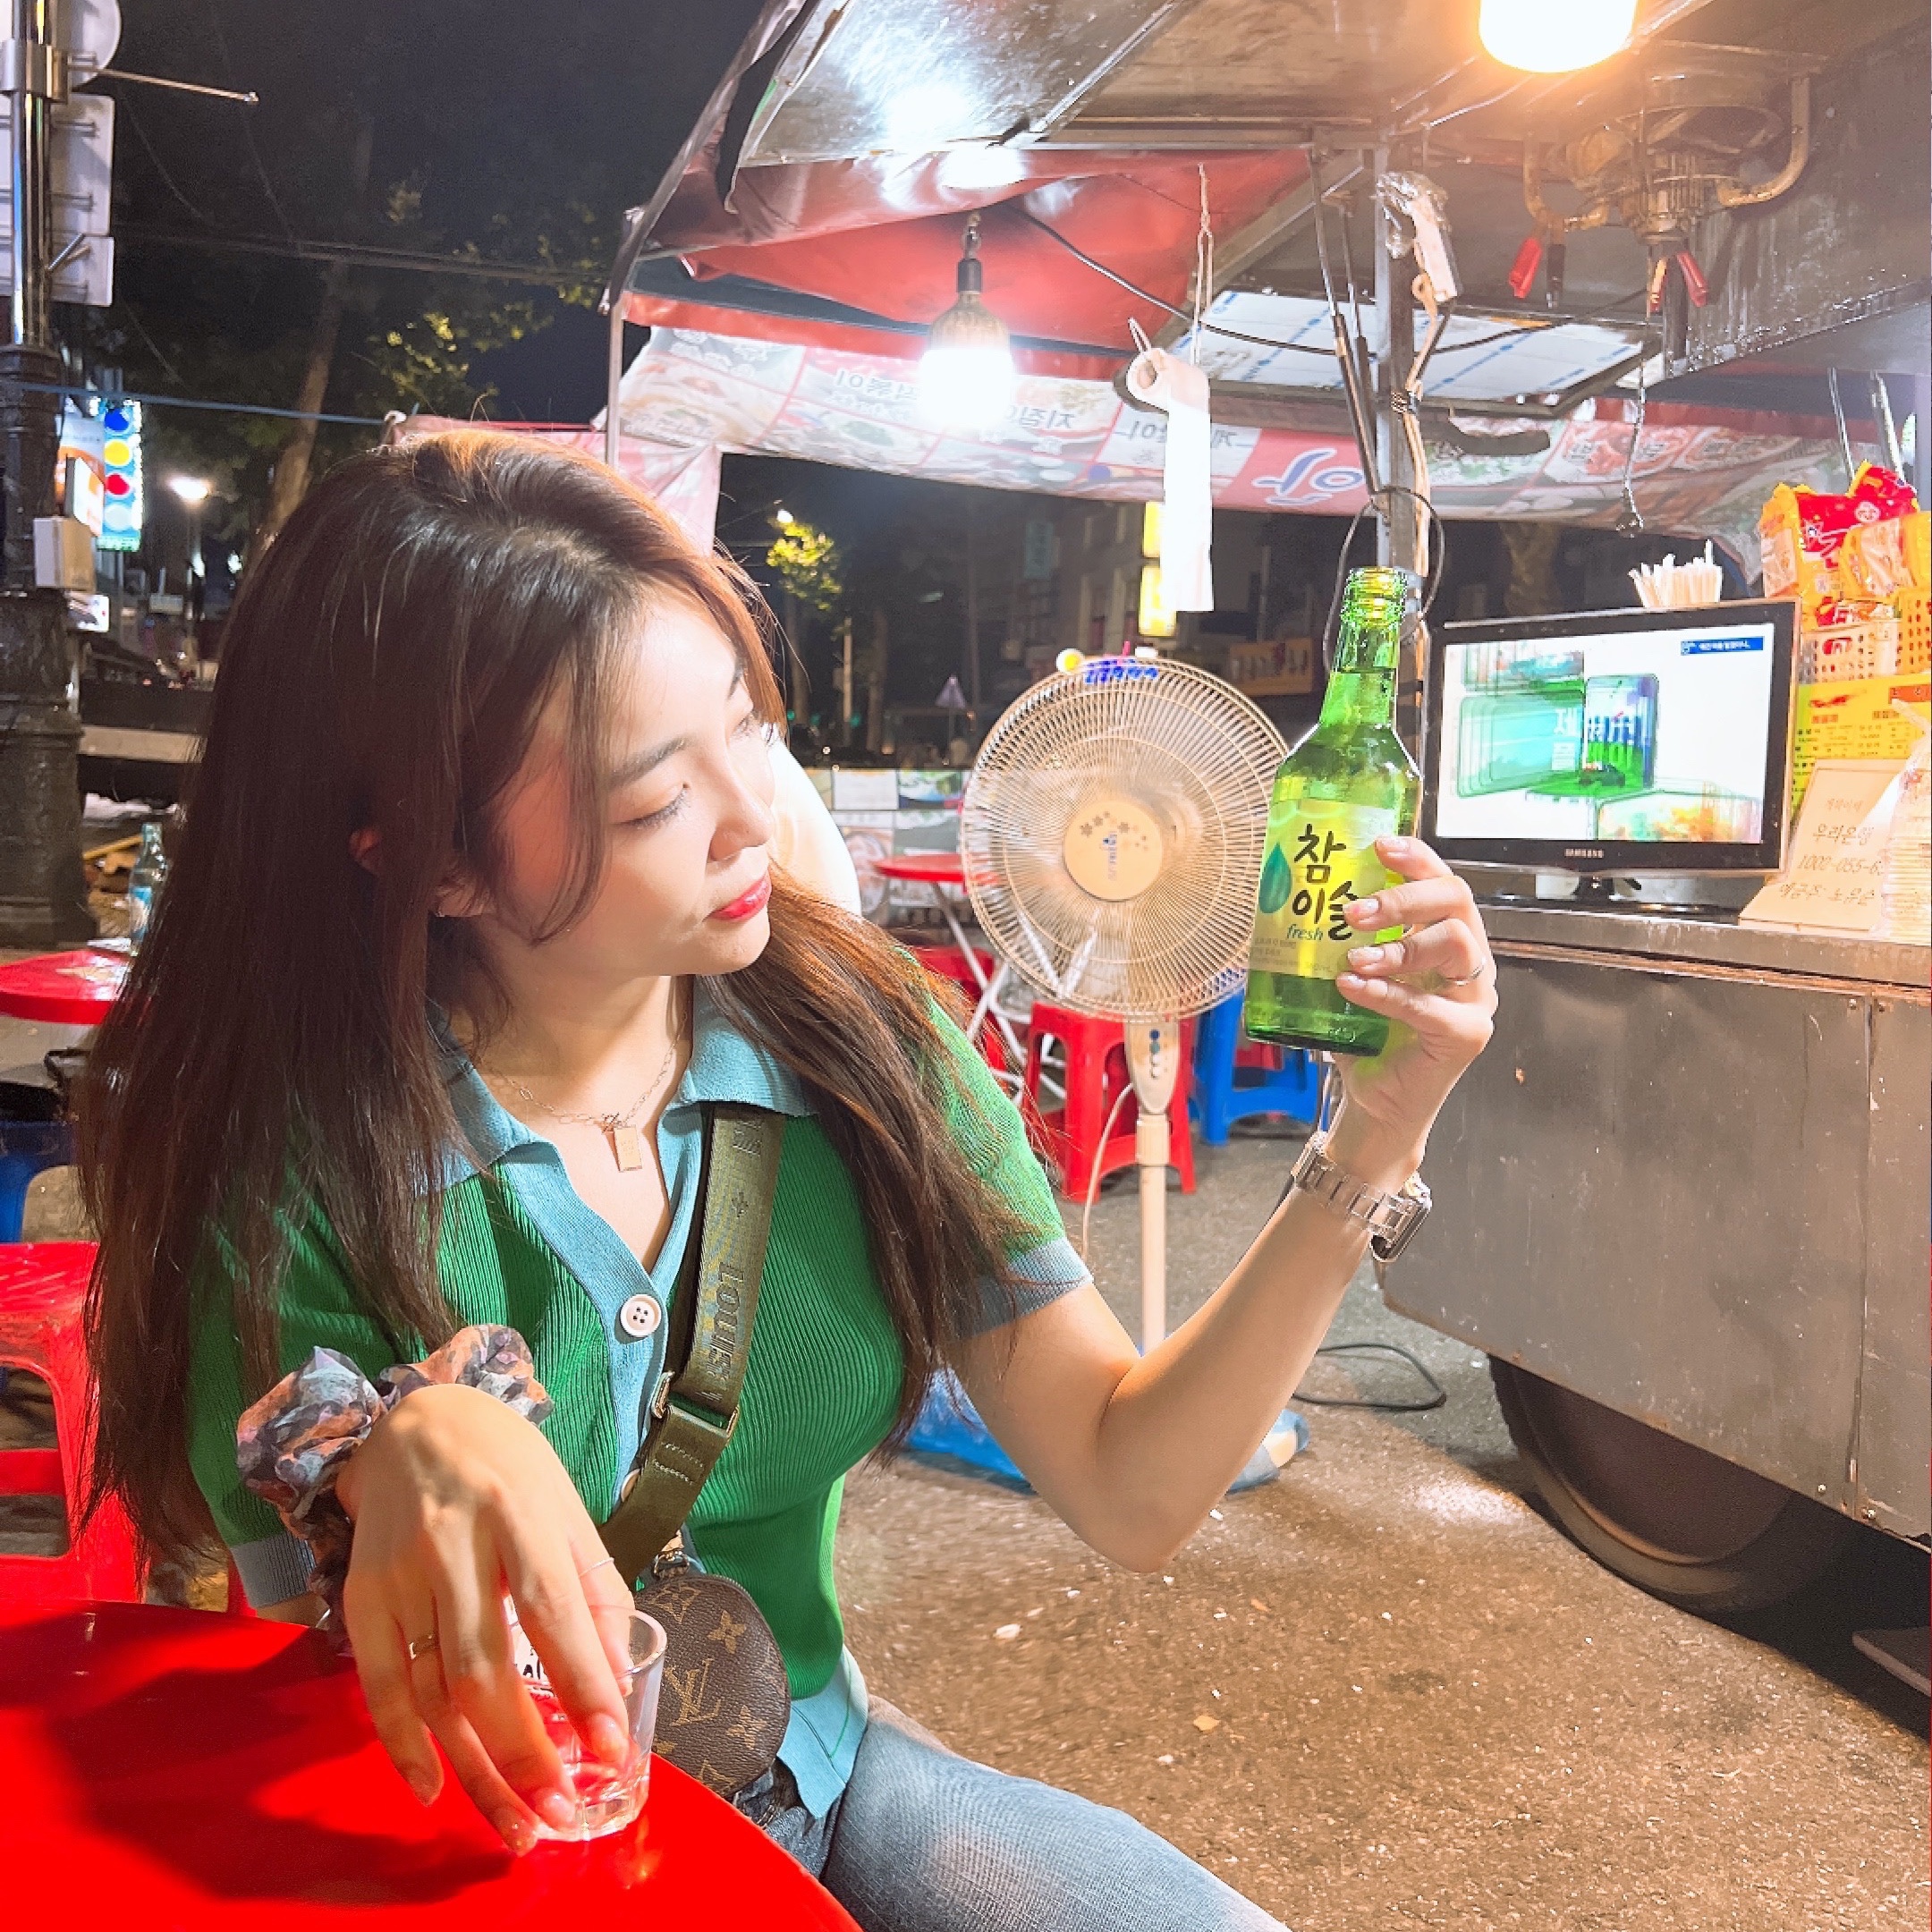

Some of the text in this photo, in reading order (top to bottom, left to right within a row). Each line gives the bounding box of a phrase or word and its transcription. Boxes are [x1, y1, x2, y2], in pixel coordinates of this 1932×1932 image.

[1812, 822, 1875, 846] 우리은행
[1293, 823, 1347, 884] 참
[1286, 922, 1324, 942] fresh
